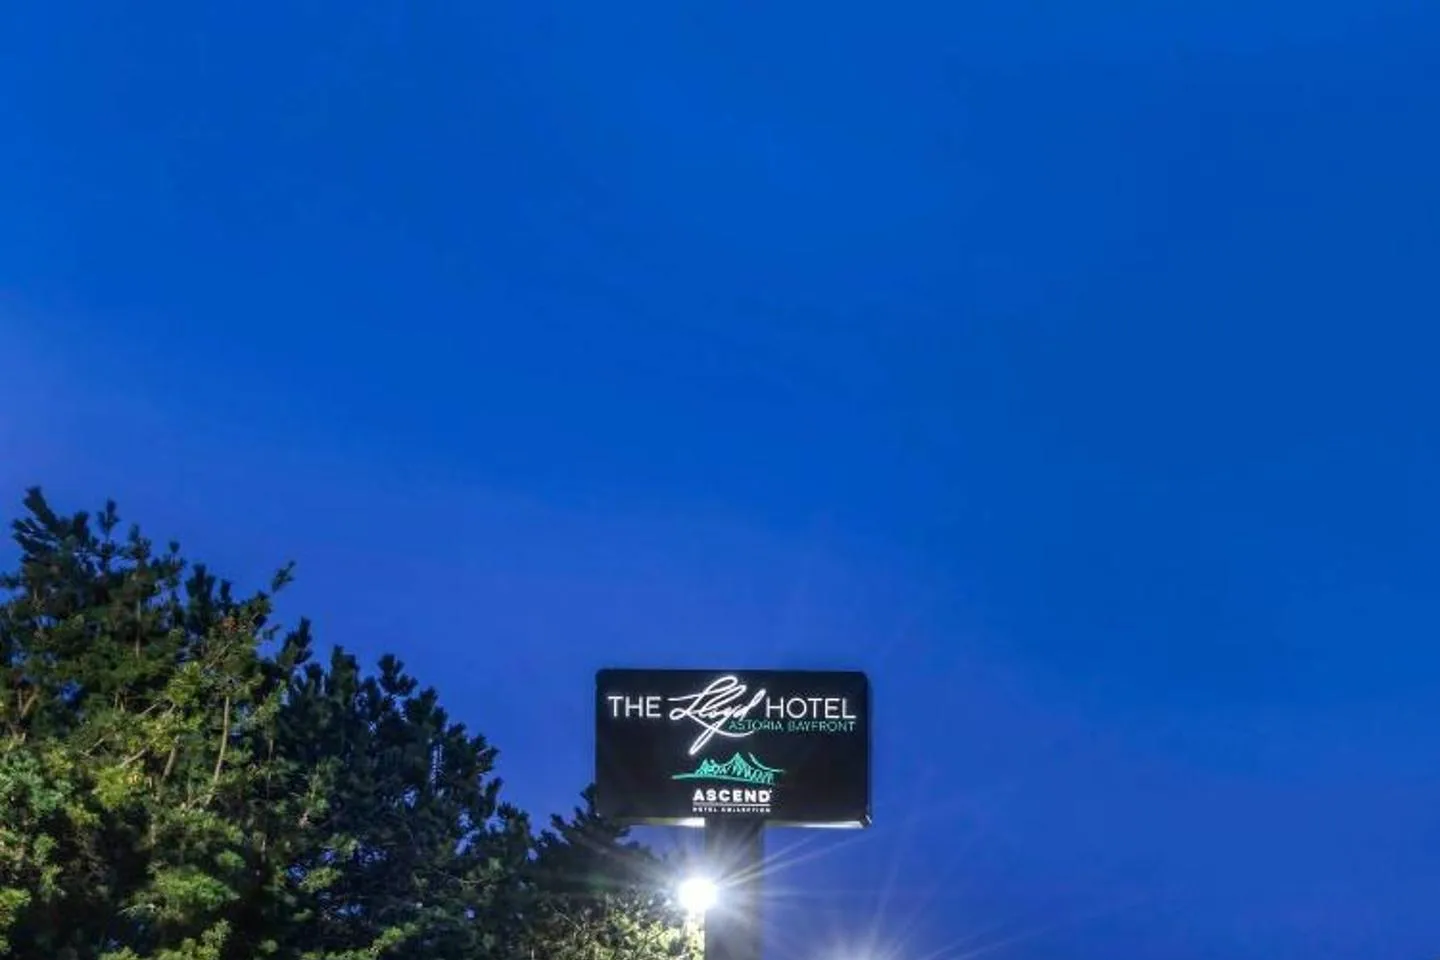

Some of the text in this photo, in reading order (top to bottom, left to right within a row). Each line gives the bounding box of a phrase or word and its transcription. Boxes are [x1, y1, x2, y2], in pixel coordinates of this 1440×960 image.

[607, 675, 857, 755] THE Lloyd HOTEL
[728, 720, 857, 733] ASTORIA BAYFRONT
[692, 788, 771, 803] ASCEND
